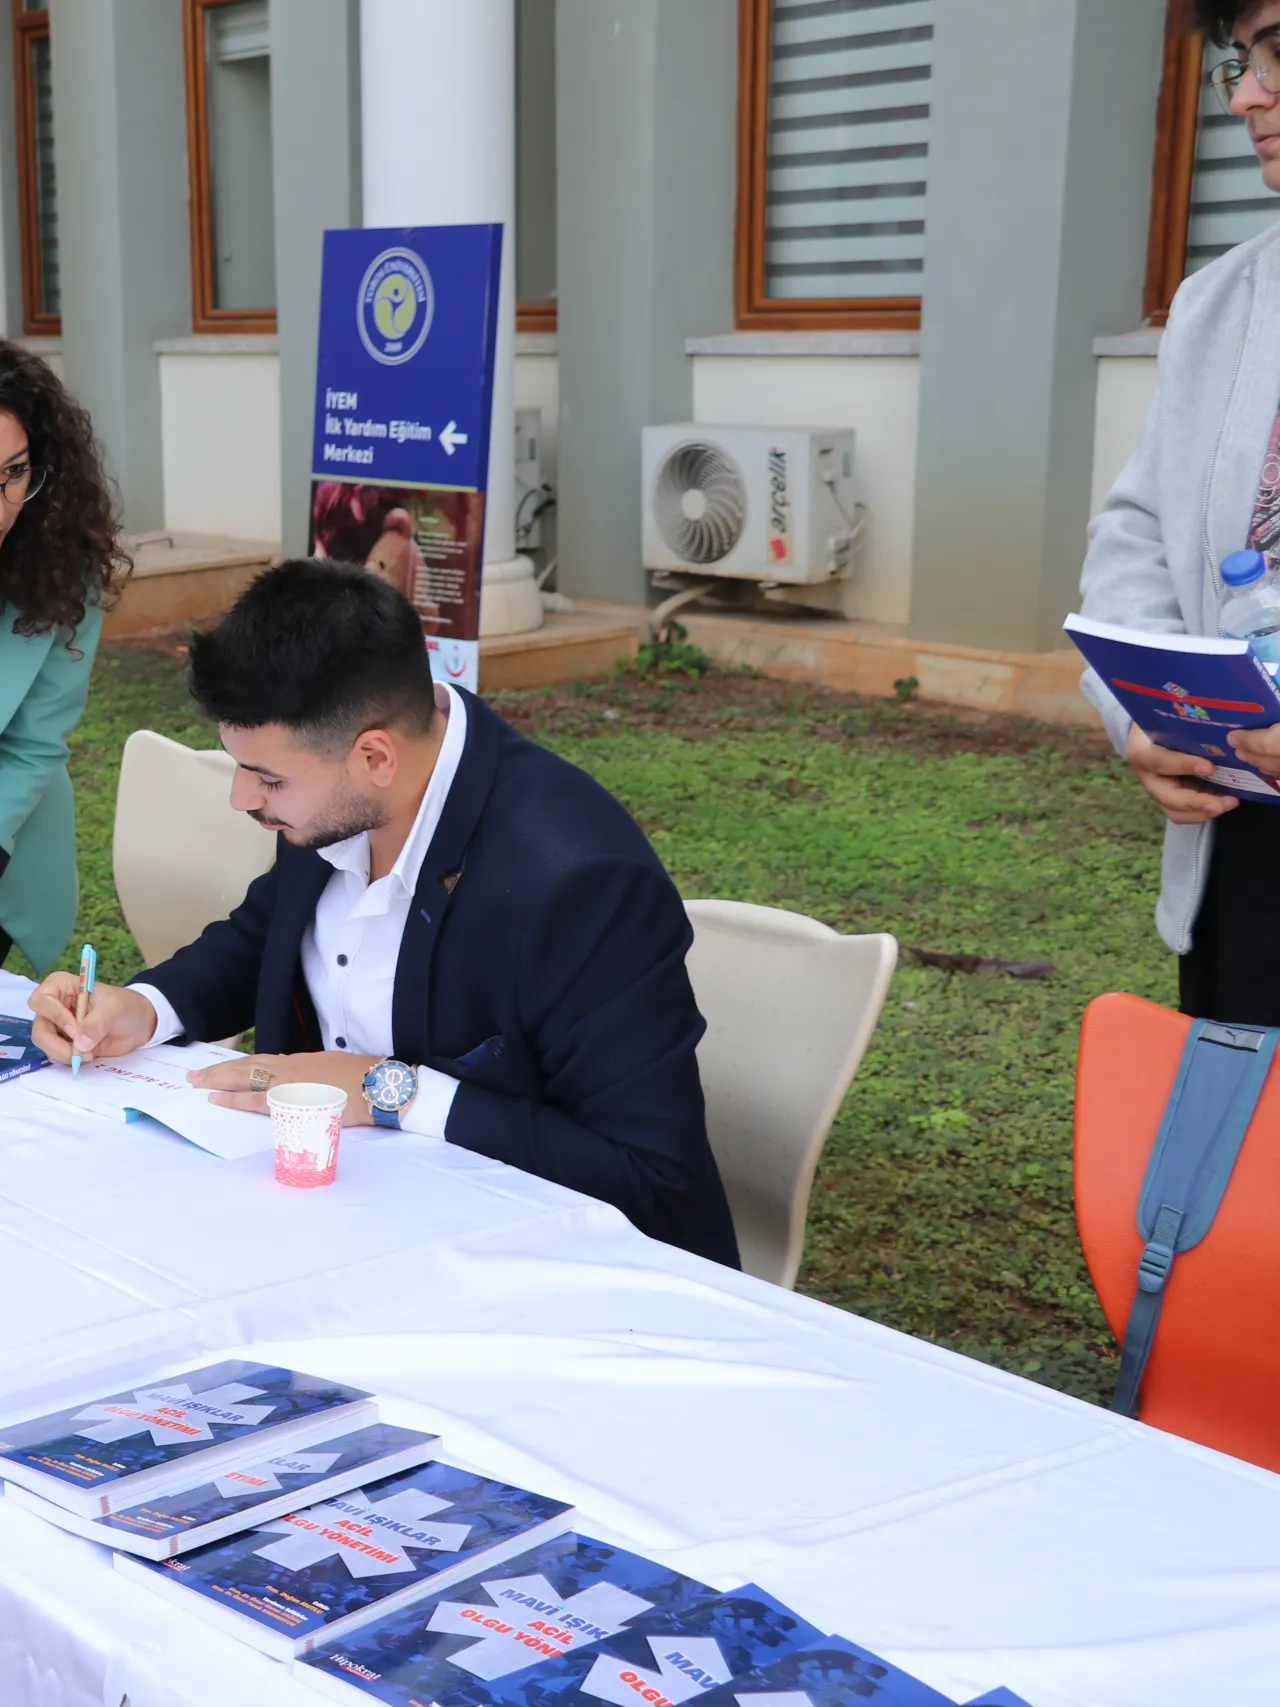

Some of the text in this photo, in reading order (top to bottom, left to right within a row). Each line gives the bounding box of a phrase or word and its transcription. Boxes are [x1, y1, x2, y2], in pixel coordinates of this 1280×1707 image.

[325, 387, 358, 410] İYEM
[325, 412, 432, 443] İlk Yardım Eğitim
[323, 443, 374, 464] Merkezi
[102, 1405, 205, 1436] OLGU YÖNETİMİ
[154, 1405, 189, 1419] ACİL
[181, 1399, 246, 1422] IŞIKLAR
[282, 1513, 402, 1564] LGU YÖNETİMİ
[333, 1518, 375, 1537] ACİL
[363, 1513, 443, 1546] IŞIKLAR
[497, 1587, 566, 1616] MAVİ
[459, 1608, 515, 1637] OLGU
[526, 1619, 576, 1646] ACİL
[329, 1653, 382, 1681] Hipokrat
